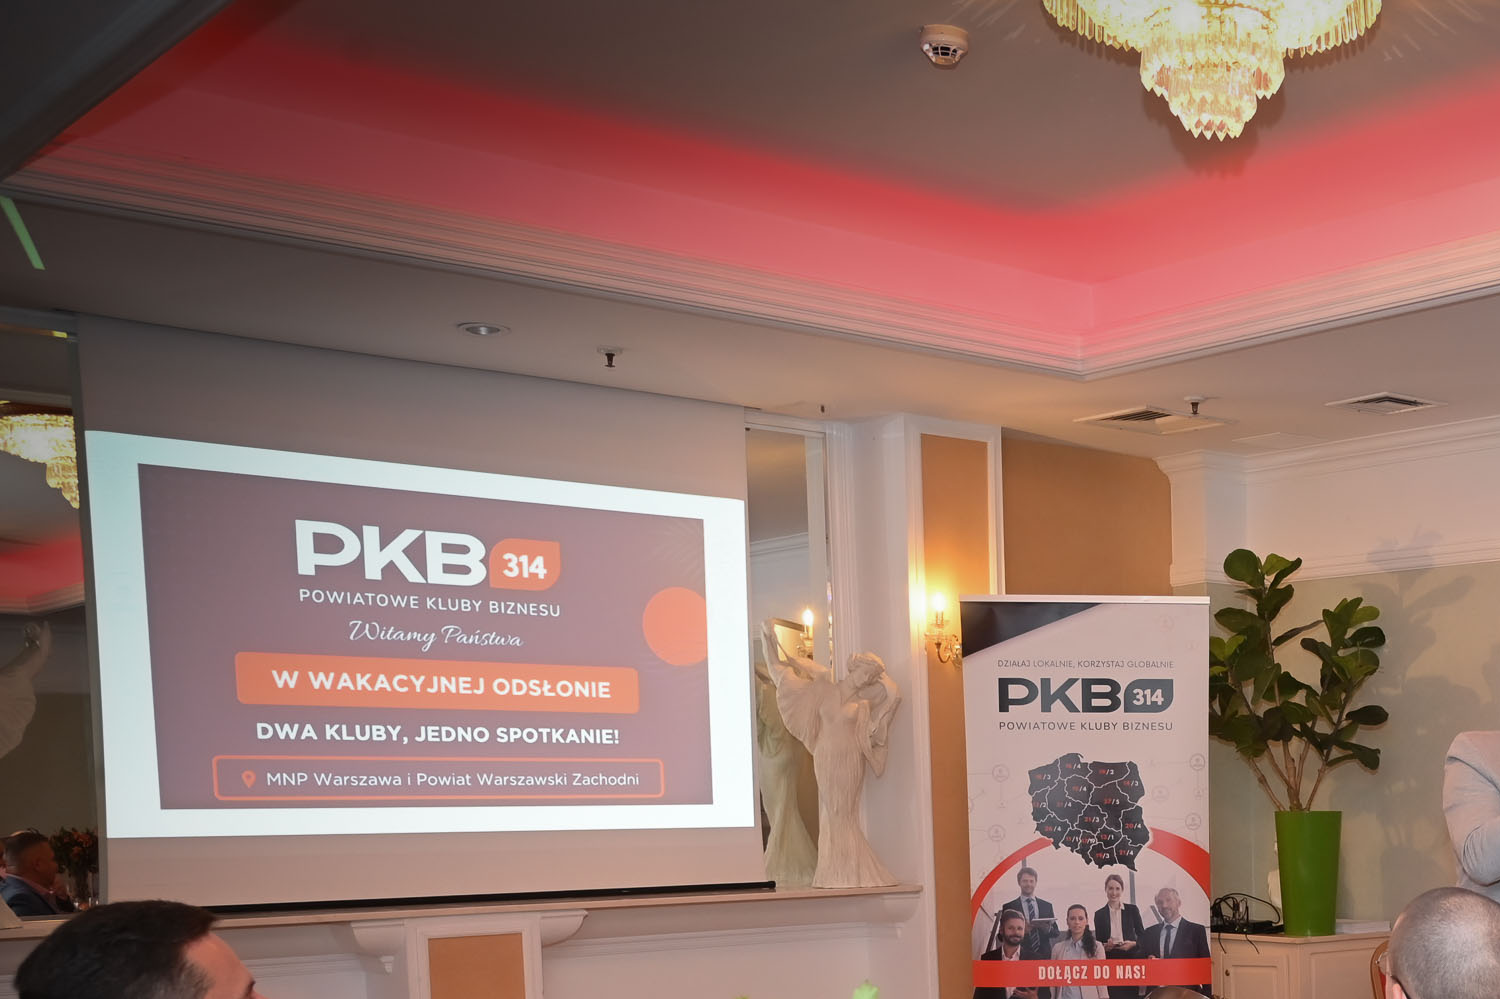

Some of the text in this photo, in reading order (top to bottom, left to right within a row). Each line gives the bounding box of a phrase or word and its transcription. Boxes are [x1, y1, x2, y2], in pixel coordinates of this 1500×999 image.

[294, 519, 548, 587] PKB 314
[298, 588, 561, 618] POWIATOWE KLUBY BIZNESU
[348, 619, 524, 651] Witamy Państwa
[997, 659, 1175, 670] DZIAŁAJ LOKALNIE, KORZYSTAJ GLOBALNIE
[271, 669, 611, 699] W WAKACYJNEJ ODSŁONIE
[998, 677, 1165, 713] PKB 314
[256, 722, 620, 745] DWA KLUBY, JEDNO SPOTKANIE!
[999, 721, 1174, 732] POWIATOWE KLUBY BIZNESU
[266, 770, 640, 788] MNP Warszawa i Powiat Warszawski Zachodni
[1038, 965, 1146, 983] DOŁĄCZ DO NAS!
